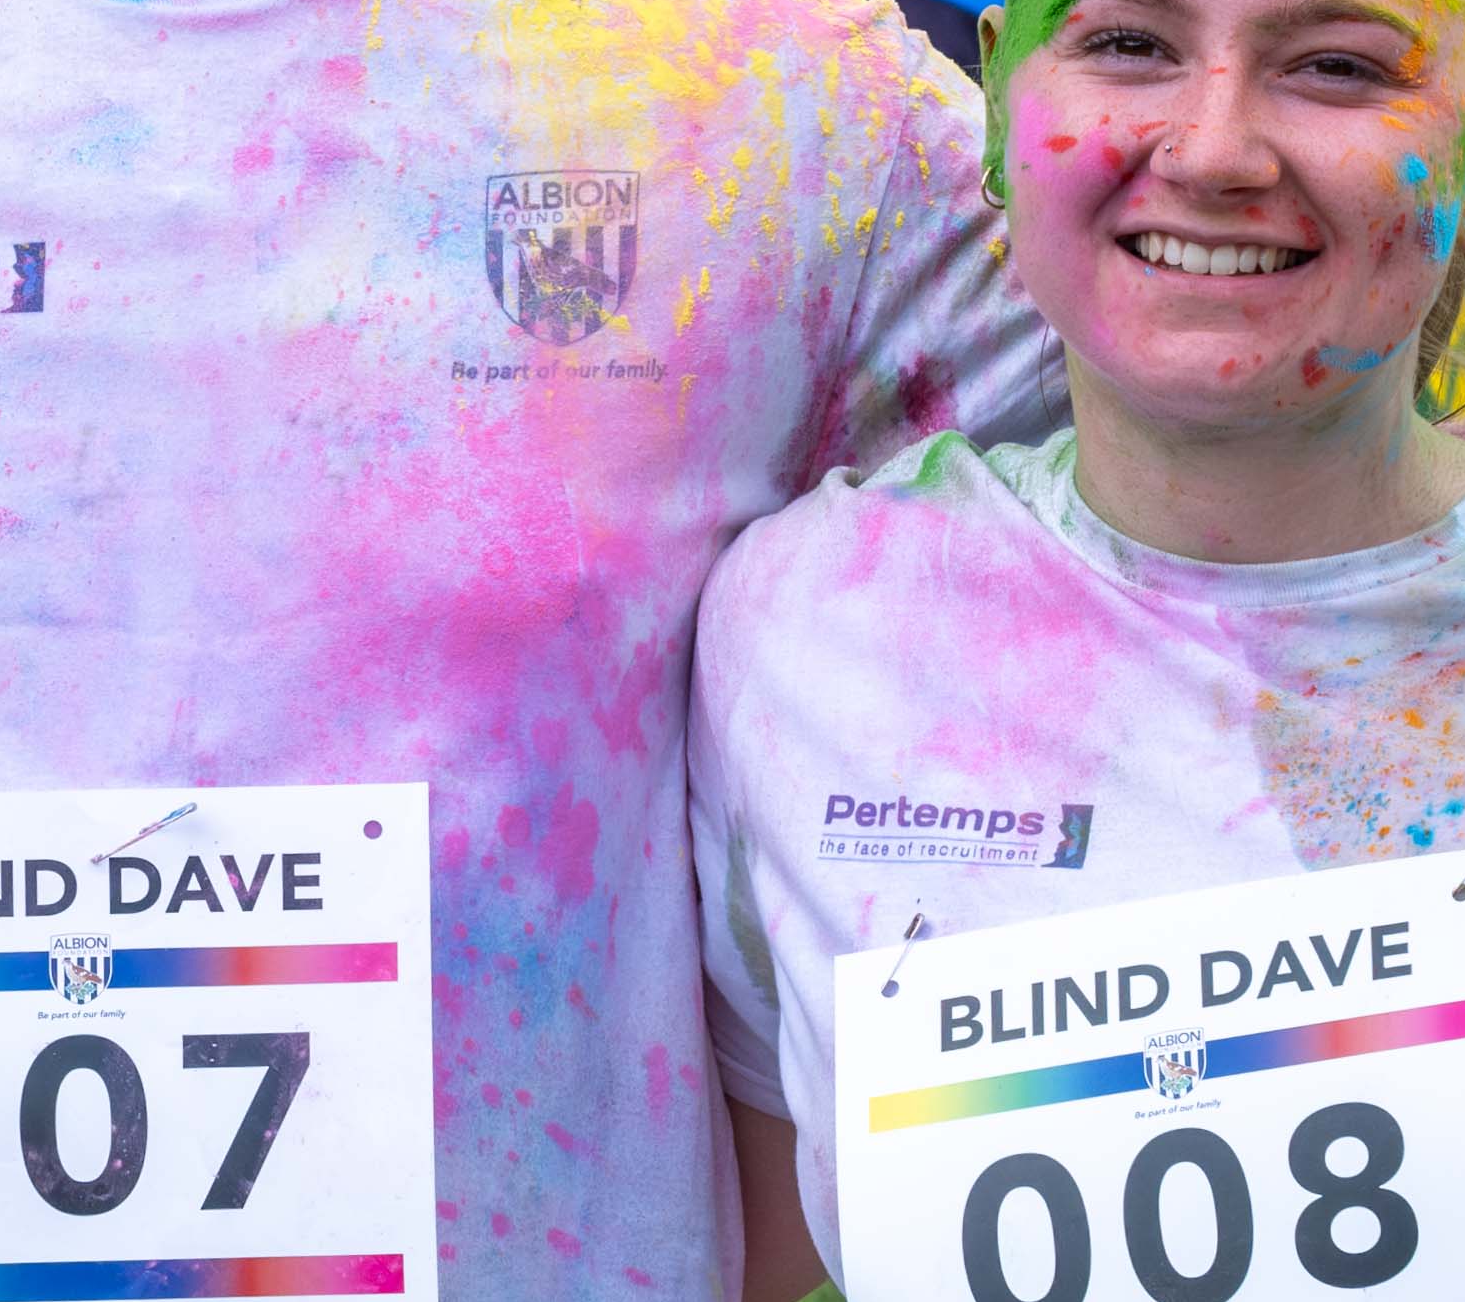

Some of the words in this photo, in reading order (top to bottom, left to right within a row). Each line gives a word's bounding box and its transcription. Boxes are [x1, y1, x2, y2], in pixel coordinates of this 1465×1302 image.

[493, 178, 631, 210] ALBION
[485, 362, 529, 383] part
[605, 358, 668, 383] family
[824, 795, 1045, 838] Pertemps
[819, 839, 846, 854] the
[853, 840, 889, 857] face
[897, 842, 914, 857] of
[919, 845, 1038, 862] recruitment
[109, 853, 322, 914] DAVE
[54, 937, 108, 950] ALBION
[942, 965, 1168, 1051] BLIND
[1201, 922, 1411, 1007] DAVE
[1148, 1030, 1201, 1049] ALBION
